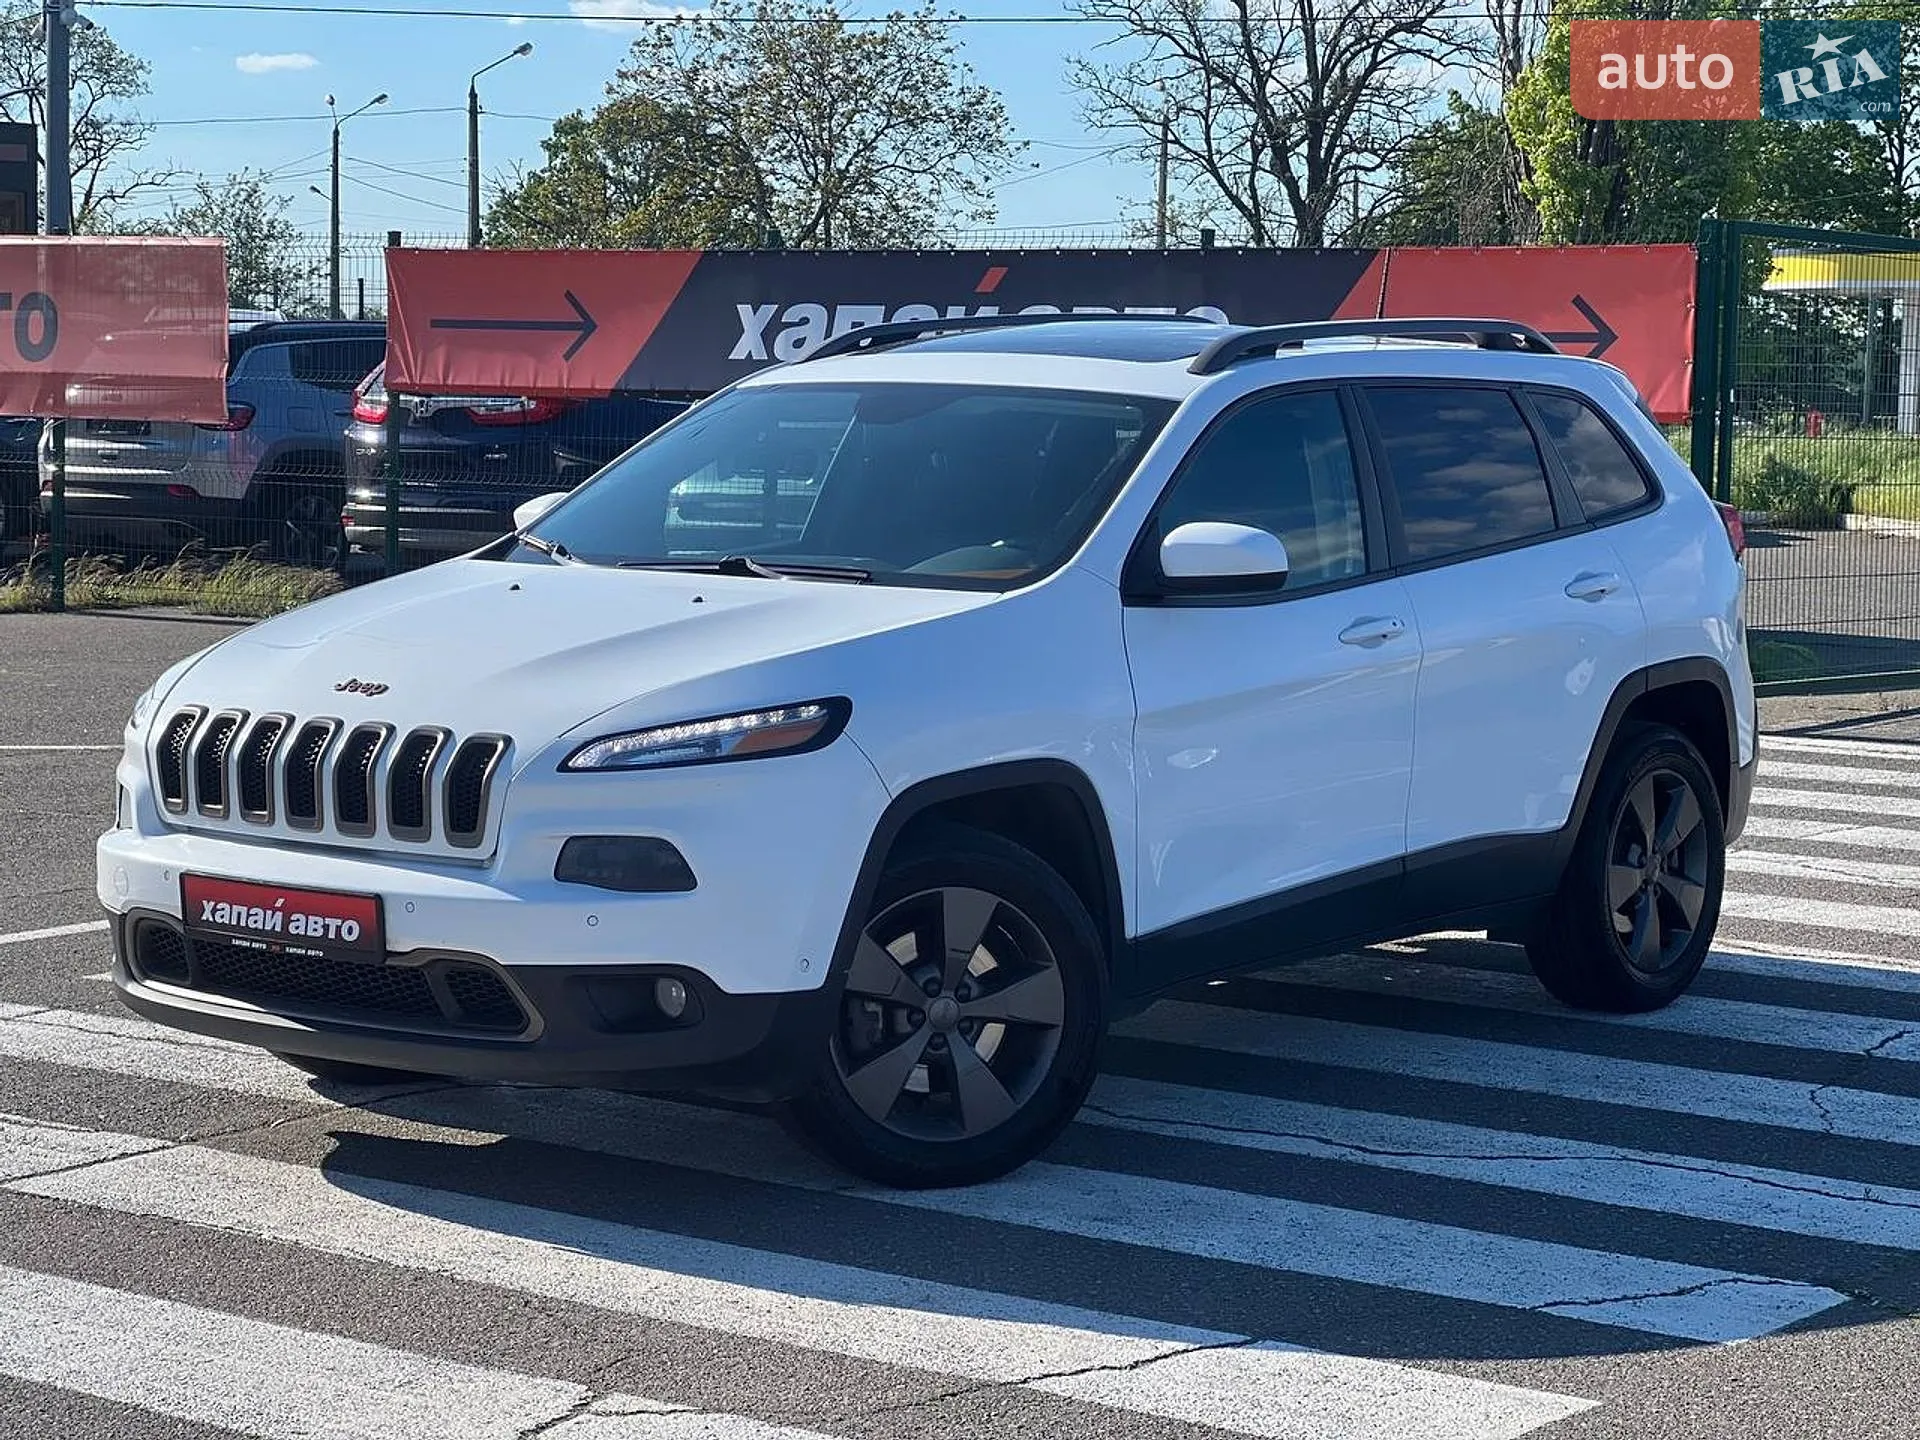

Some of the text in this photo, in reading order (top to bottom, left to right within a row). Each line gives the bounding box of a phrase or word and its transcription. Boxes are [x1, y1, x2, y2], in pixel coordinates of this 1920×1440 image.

[334, 678, 389, 697] Jeep
[200, 898, 361, 942] хапай авто
